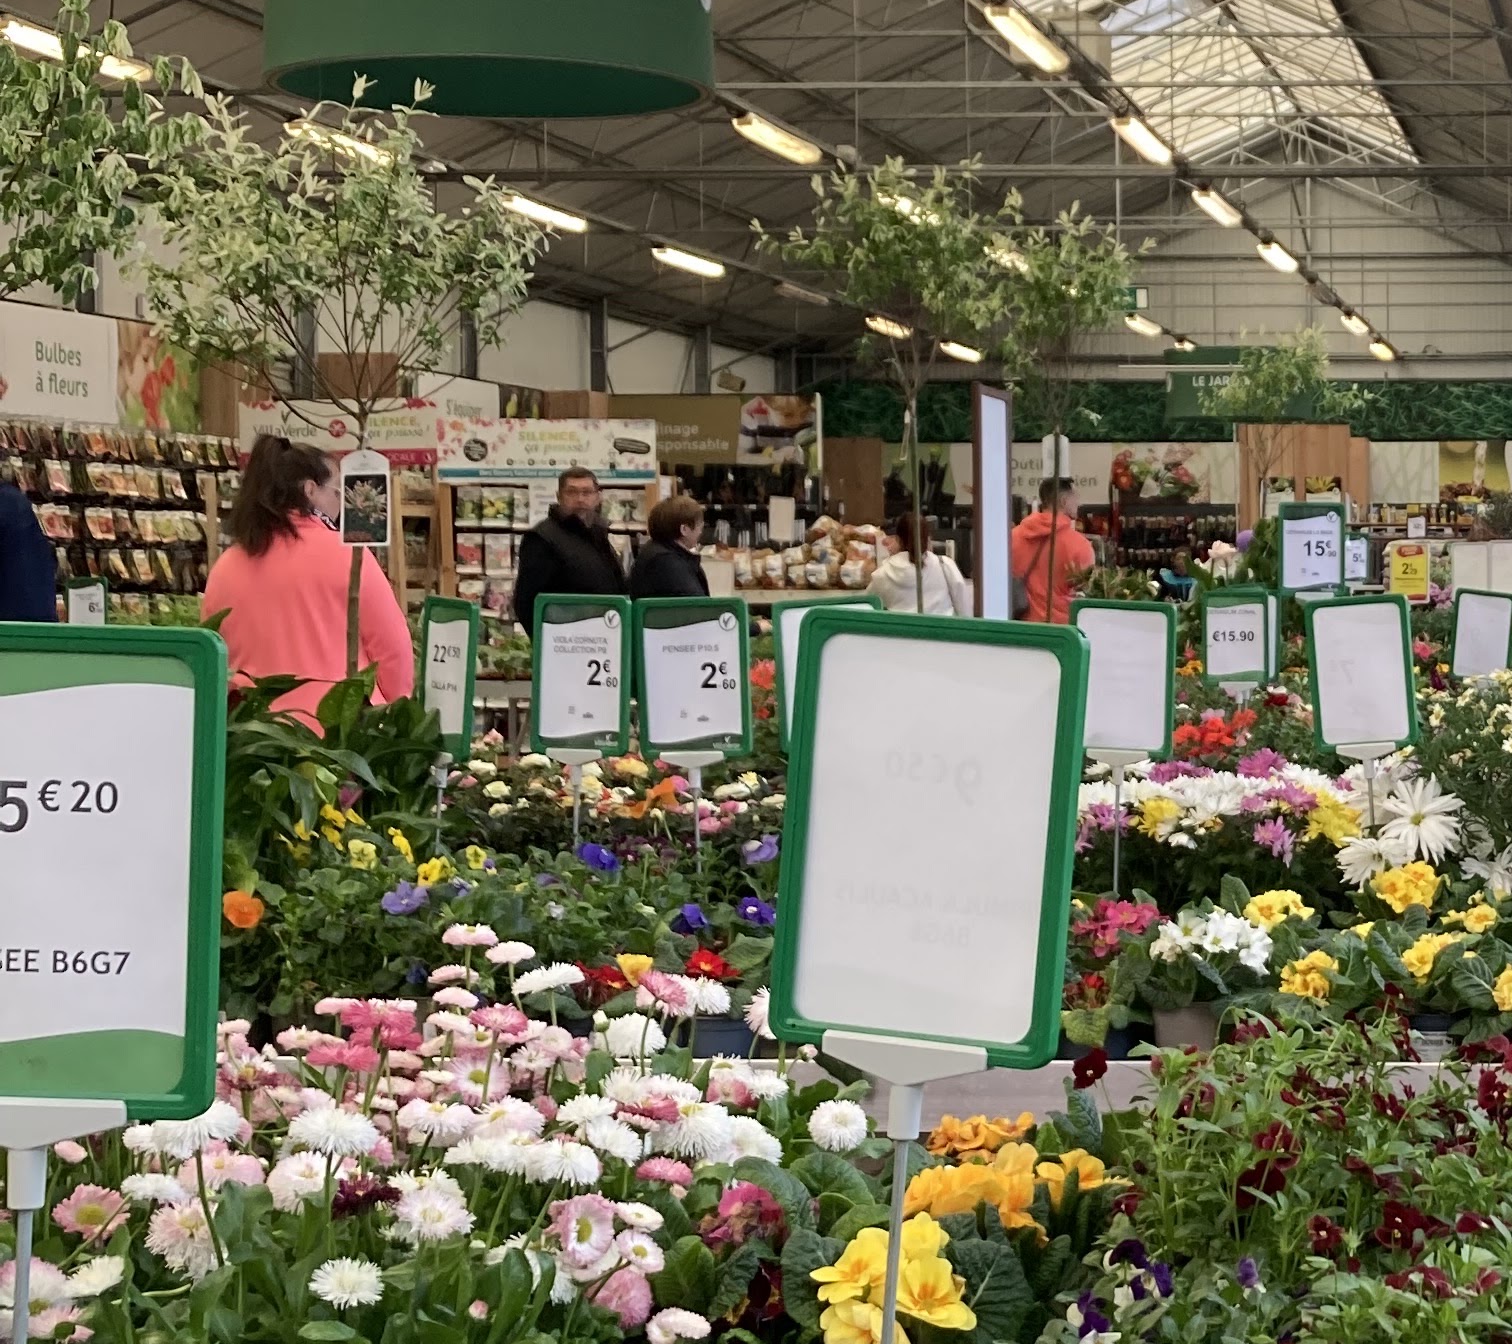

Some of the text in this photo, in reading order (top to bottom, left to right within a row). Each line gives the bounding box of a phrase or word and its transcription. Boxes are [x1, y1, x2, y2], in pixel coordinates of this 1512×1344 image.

[35, 341, 82, 367] Bulbes
[35, 371, 89, 398] à fleurs
[656, 438, 730, 453] sponsable
[1212, 630, 1255, 642] €15.90
[52, 950, 130, 975] B6G7
